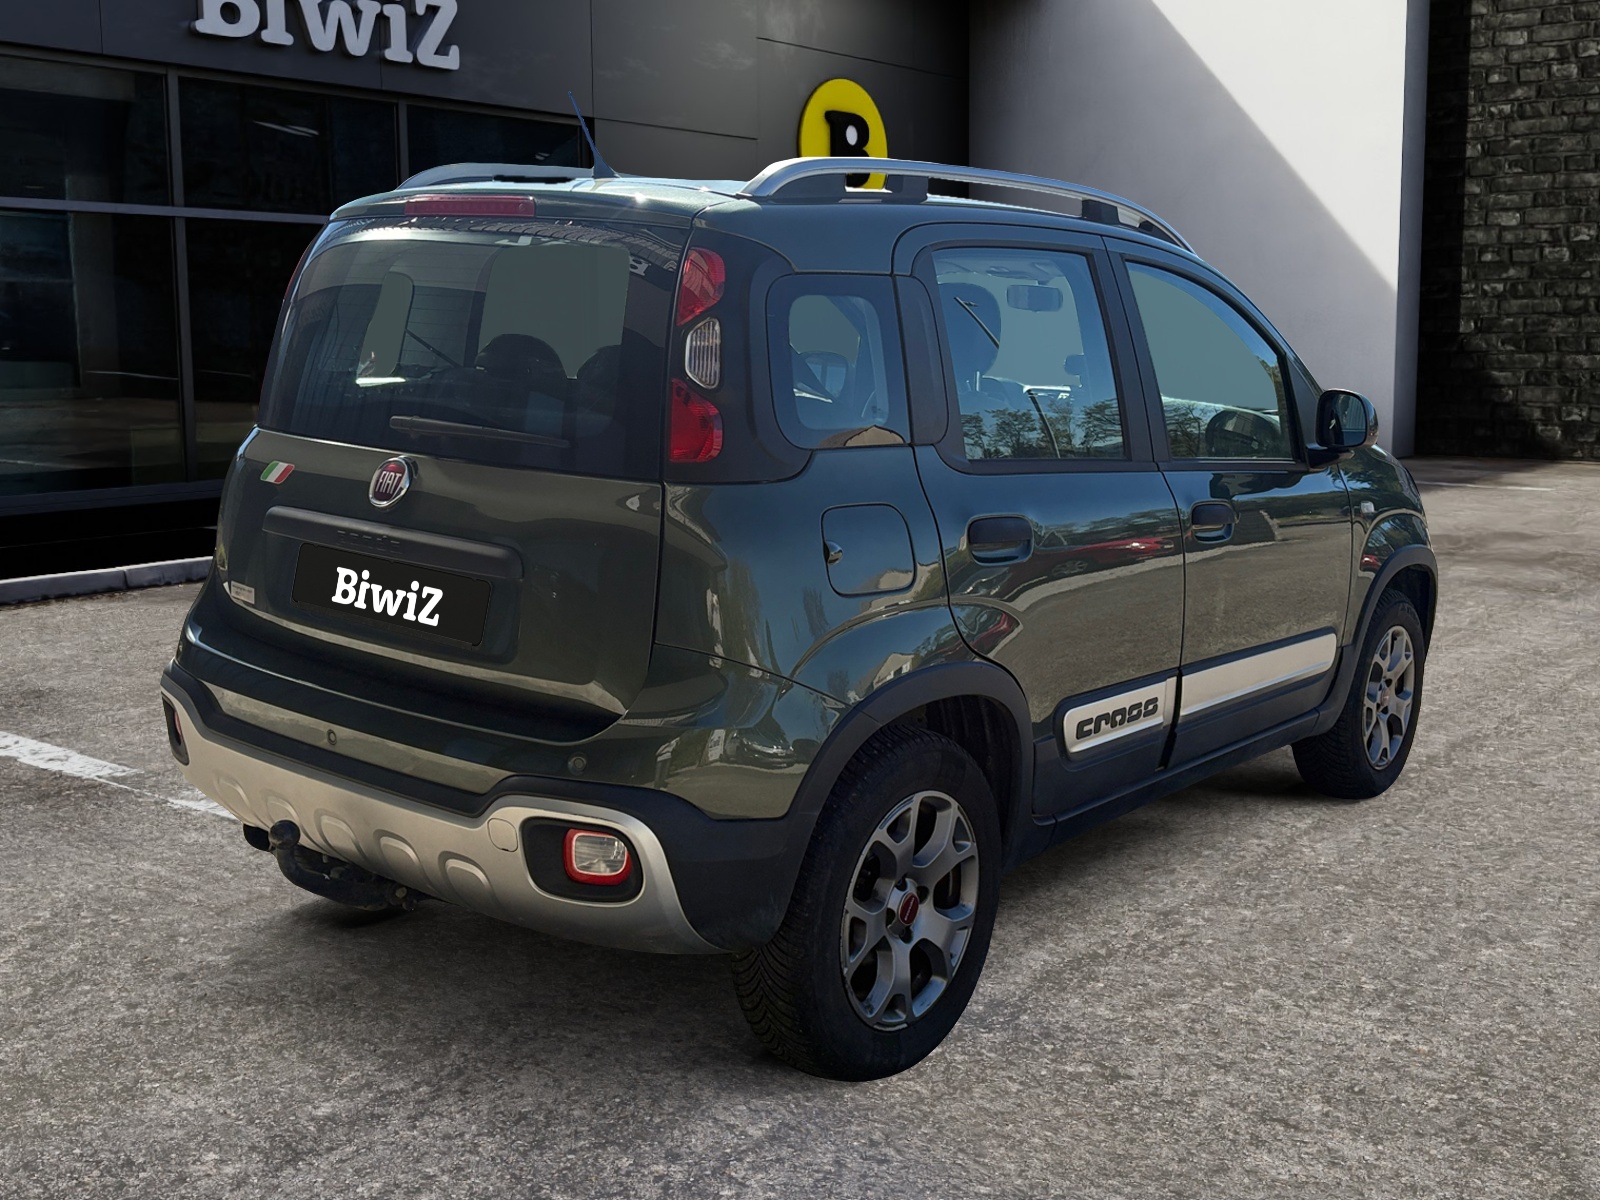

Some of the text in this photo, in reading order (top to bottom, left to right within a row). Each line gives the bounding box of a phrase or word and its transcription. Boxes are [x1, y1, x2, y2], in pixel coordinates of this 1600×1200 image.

[824, 110, 870, 188] B
[375, 471, 402, 494] FIAT
[331, 566, 443, 627] BiwiZ
